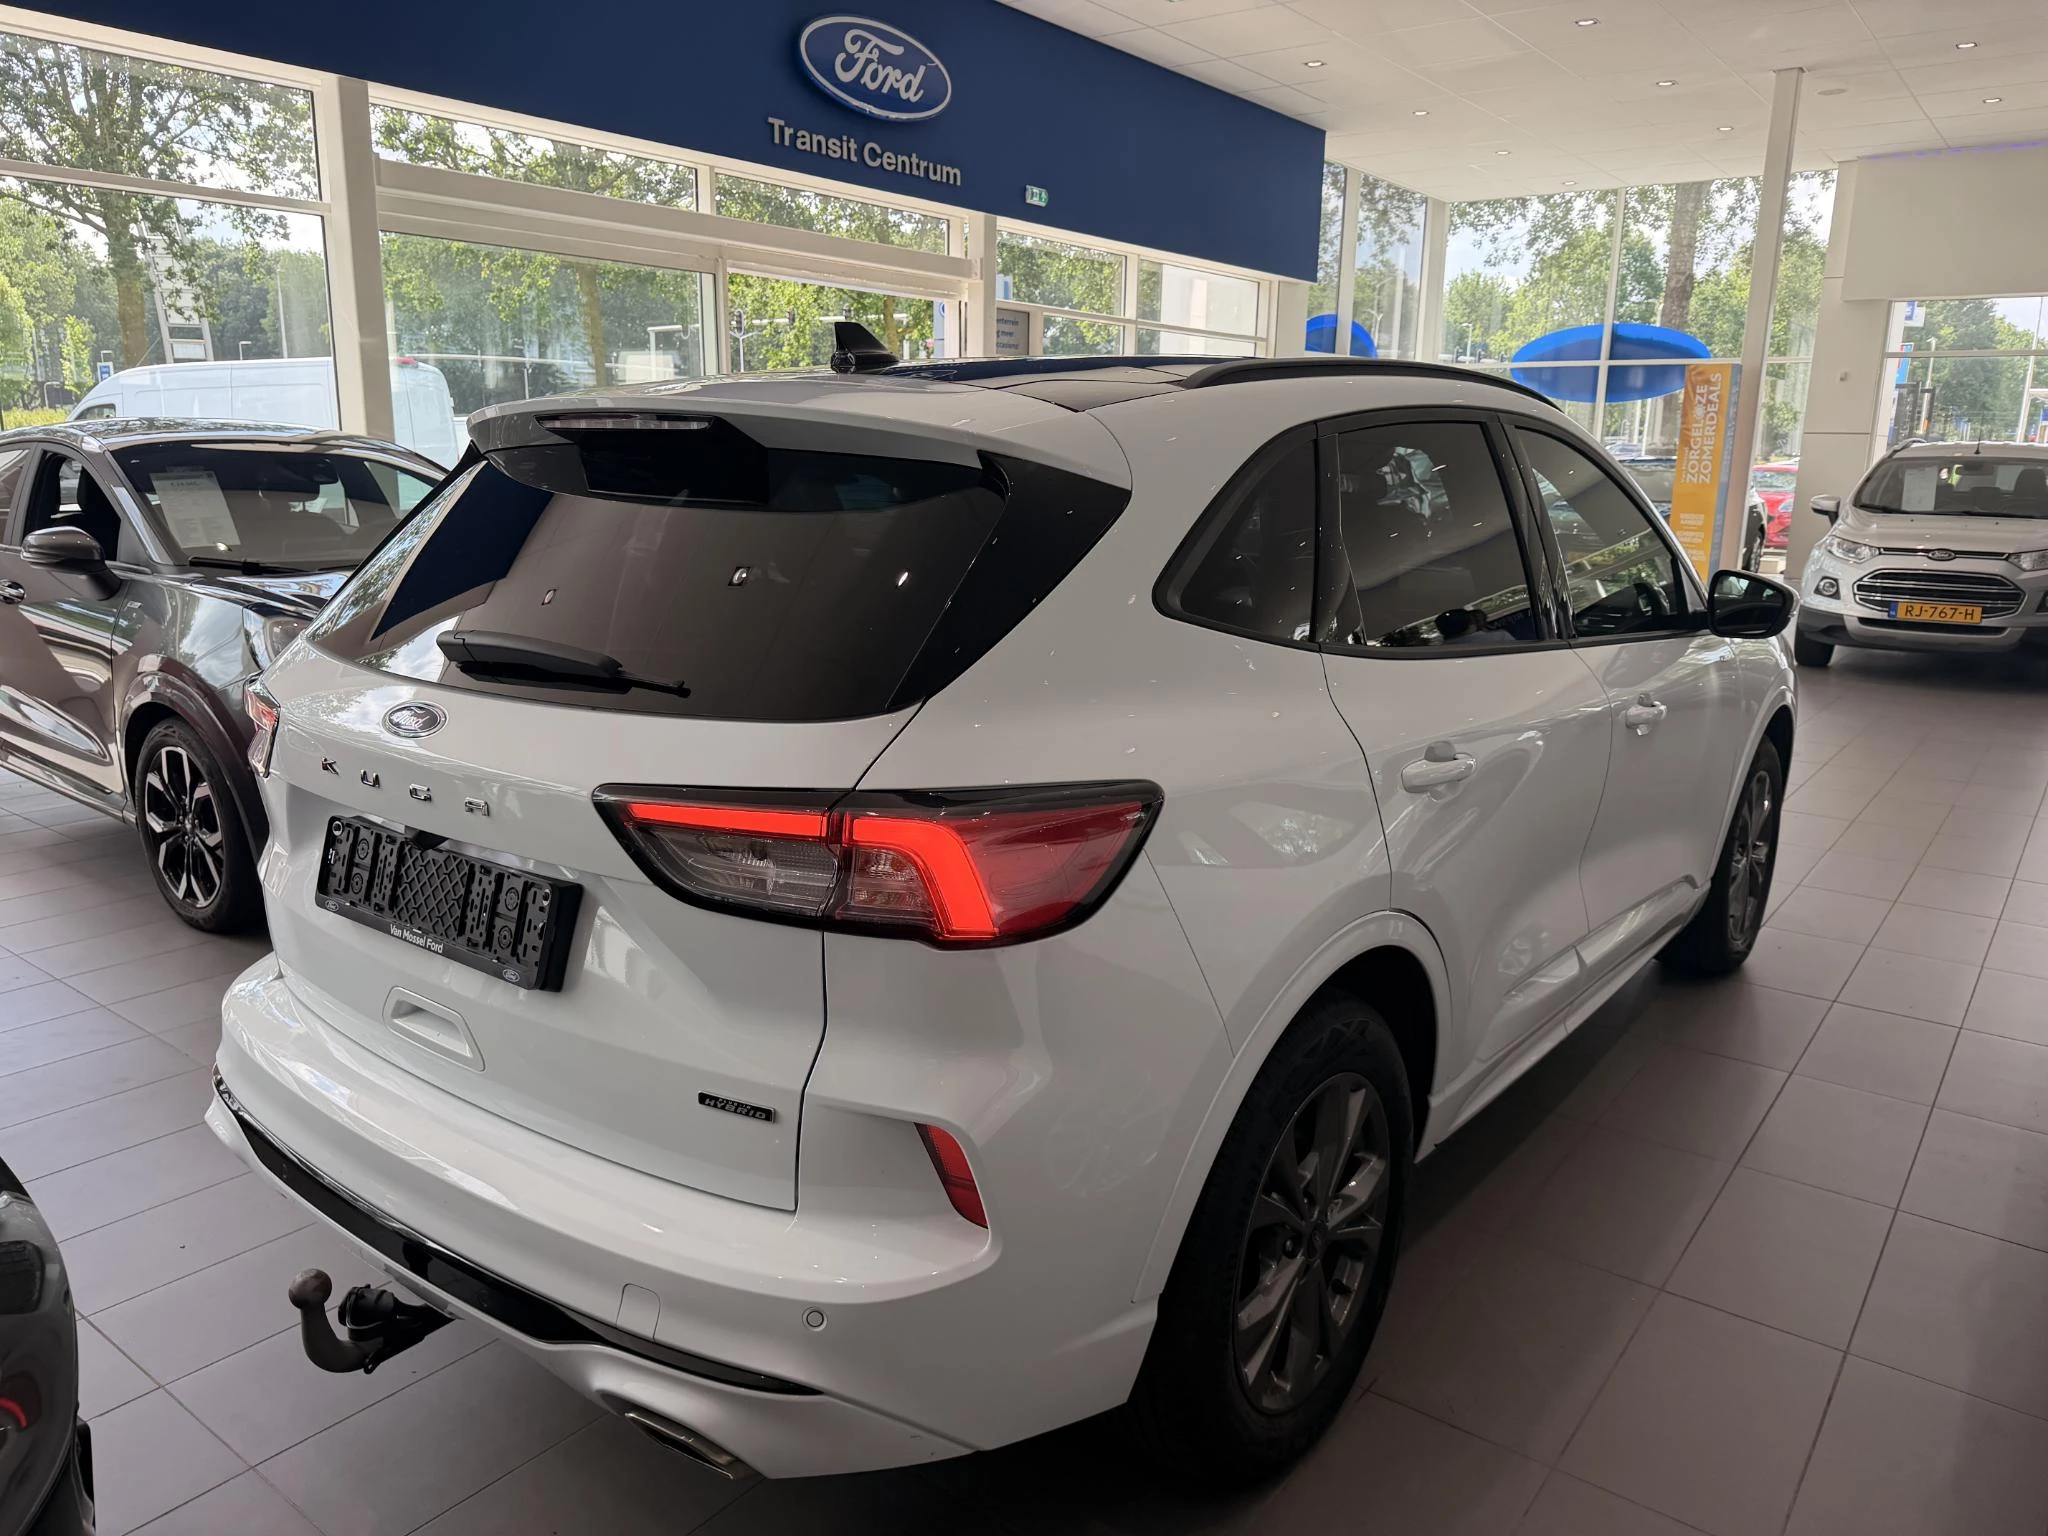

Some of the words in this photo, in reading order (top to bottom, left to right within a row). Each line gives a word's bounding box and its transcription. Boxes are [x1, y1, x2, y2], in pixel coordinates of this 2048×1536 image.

[834, 28, 928, 103] Ford
[767, 117, 858, 163] Transit
[863, 142, 962, 187] Centrum
[1698, 372, 1722, 485] ZOMERDEALS
[1904, 605, 1975, 621] RJ-767-H
[321, 756, 490, 817] KUGA
[390, 923, 402, 938] Van
[402, 928, 427, 947] Mossel
[426, 937, 443, 953] Ford
[704, 1098, 766, 1119] HYBRID
